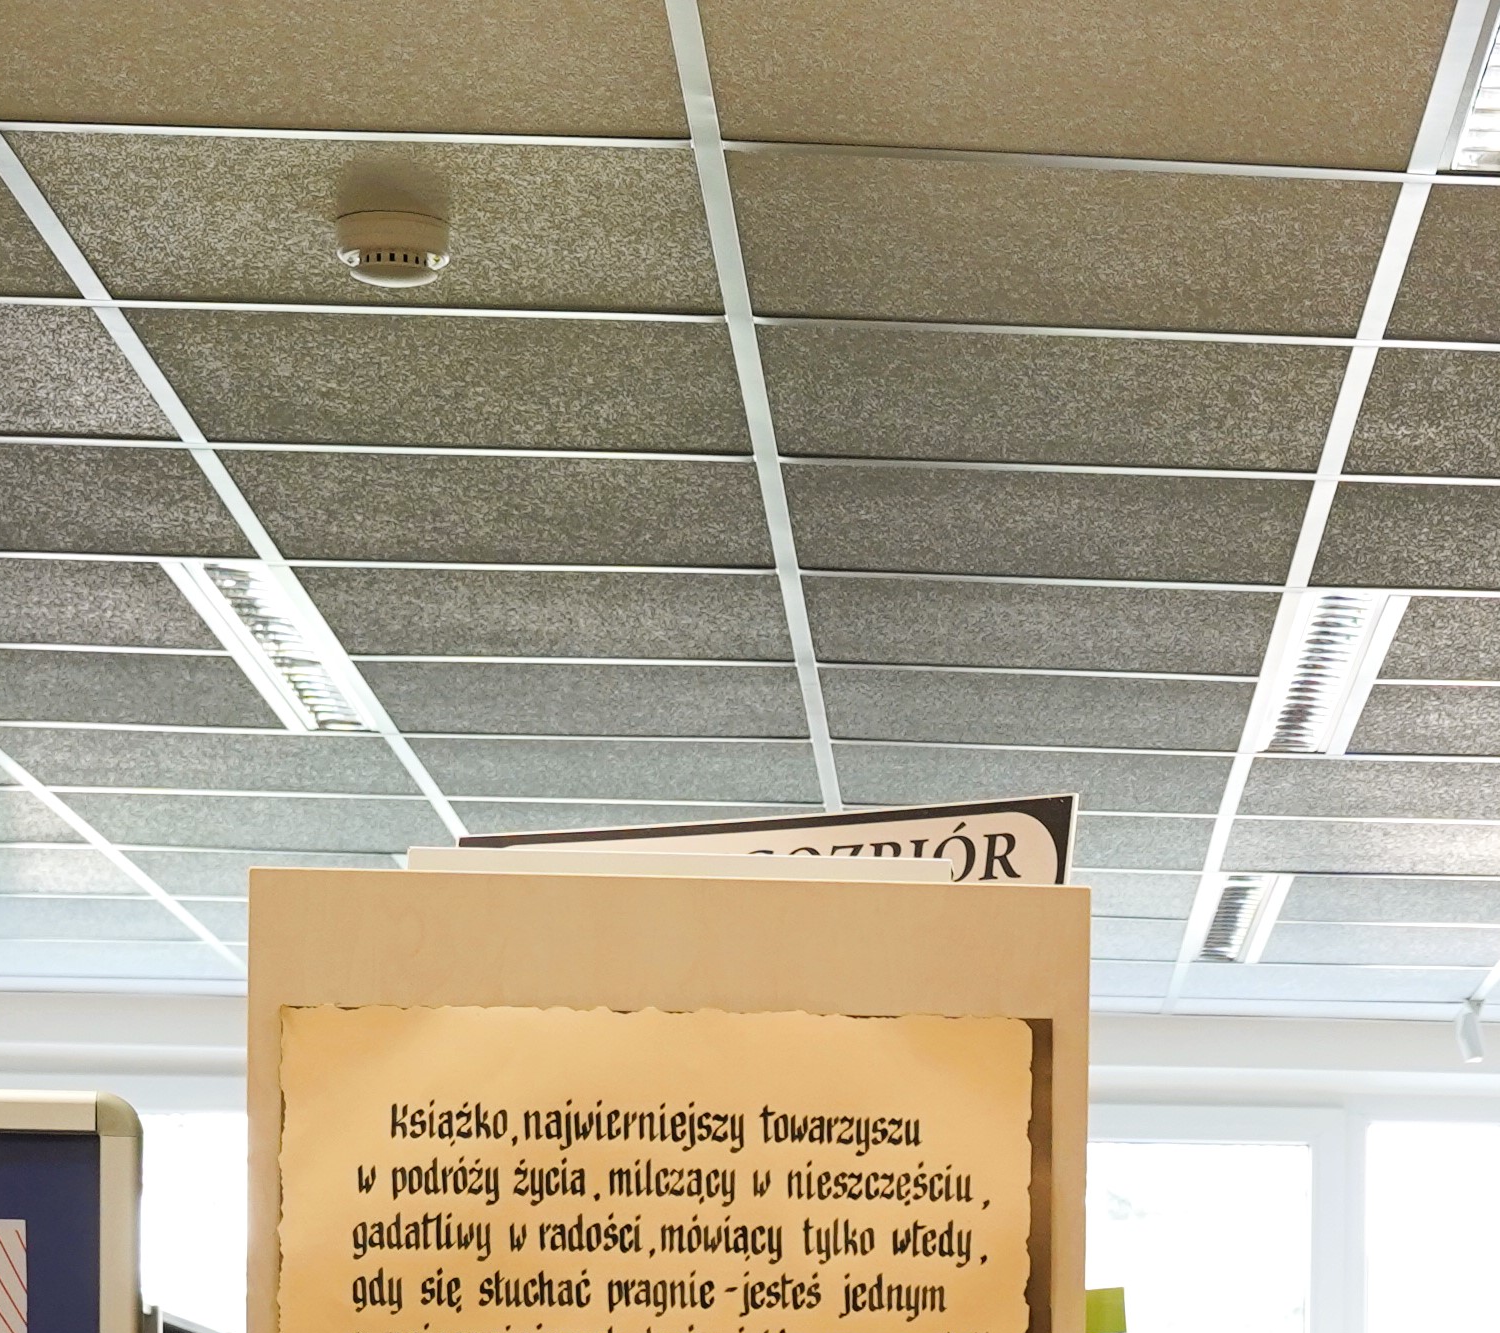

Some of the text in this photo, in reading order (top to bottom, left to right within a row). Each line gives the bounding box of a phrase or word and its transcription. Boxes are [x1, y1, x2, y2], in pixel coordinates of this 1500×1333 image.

[523, 1099, 745, 1154] najwierniejszy
[759, 1104, 921, 1157] towarzyszu
[357, 1165, 377, 1194] w
[391, 1157, 500, 1206] podróży
[608, 1159, 736, 1208] milczący
[752, 1169, 771, 1198] w
[352, 1267, 403, 1316] gdy
[420, 1267, 462, 1314] się
[478, 1269, 591, 1309] słuchać
[607, 1270, 715, 1318] pragnie
[838, 1272, 947, 1321] jednym
